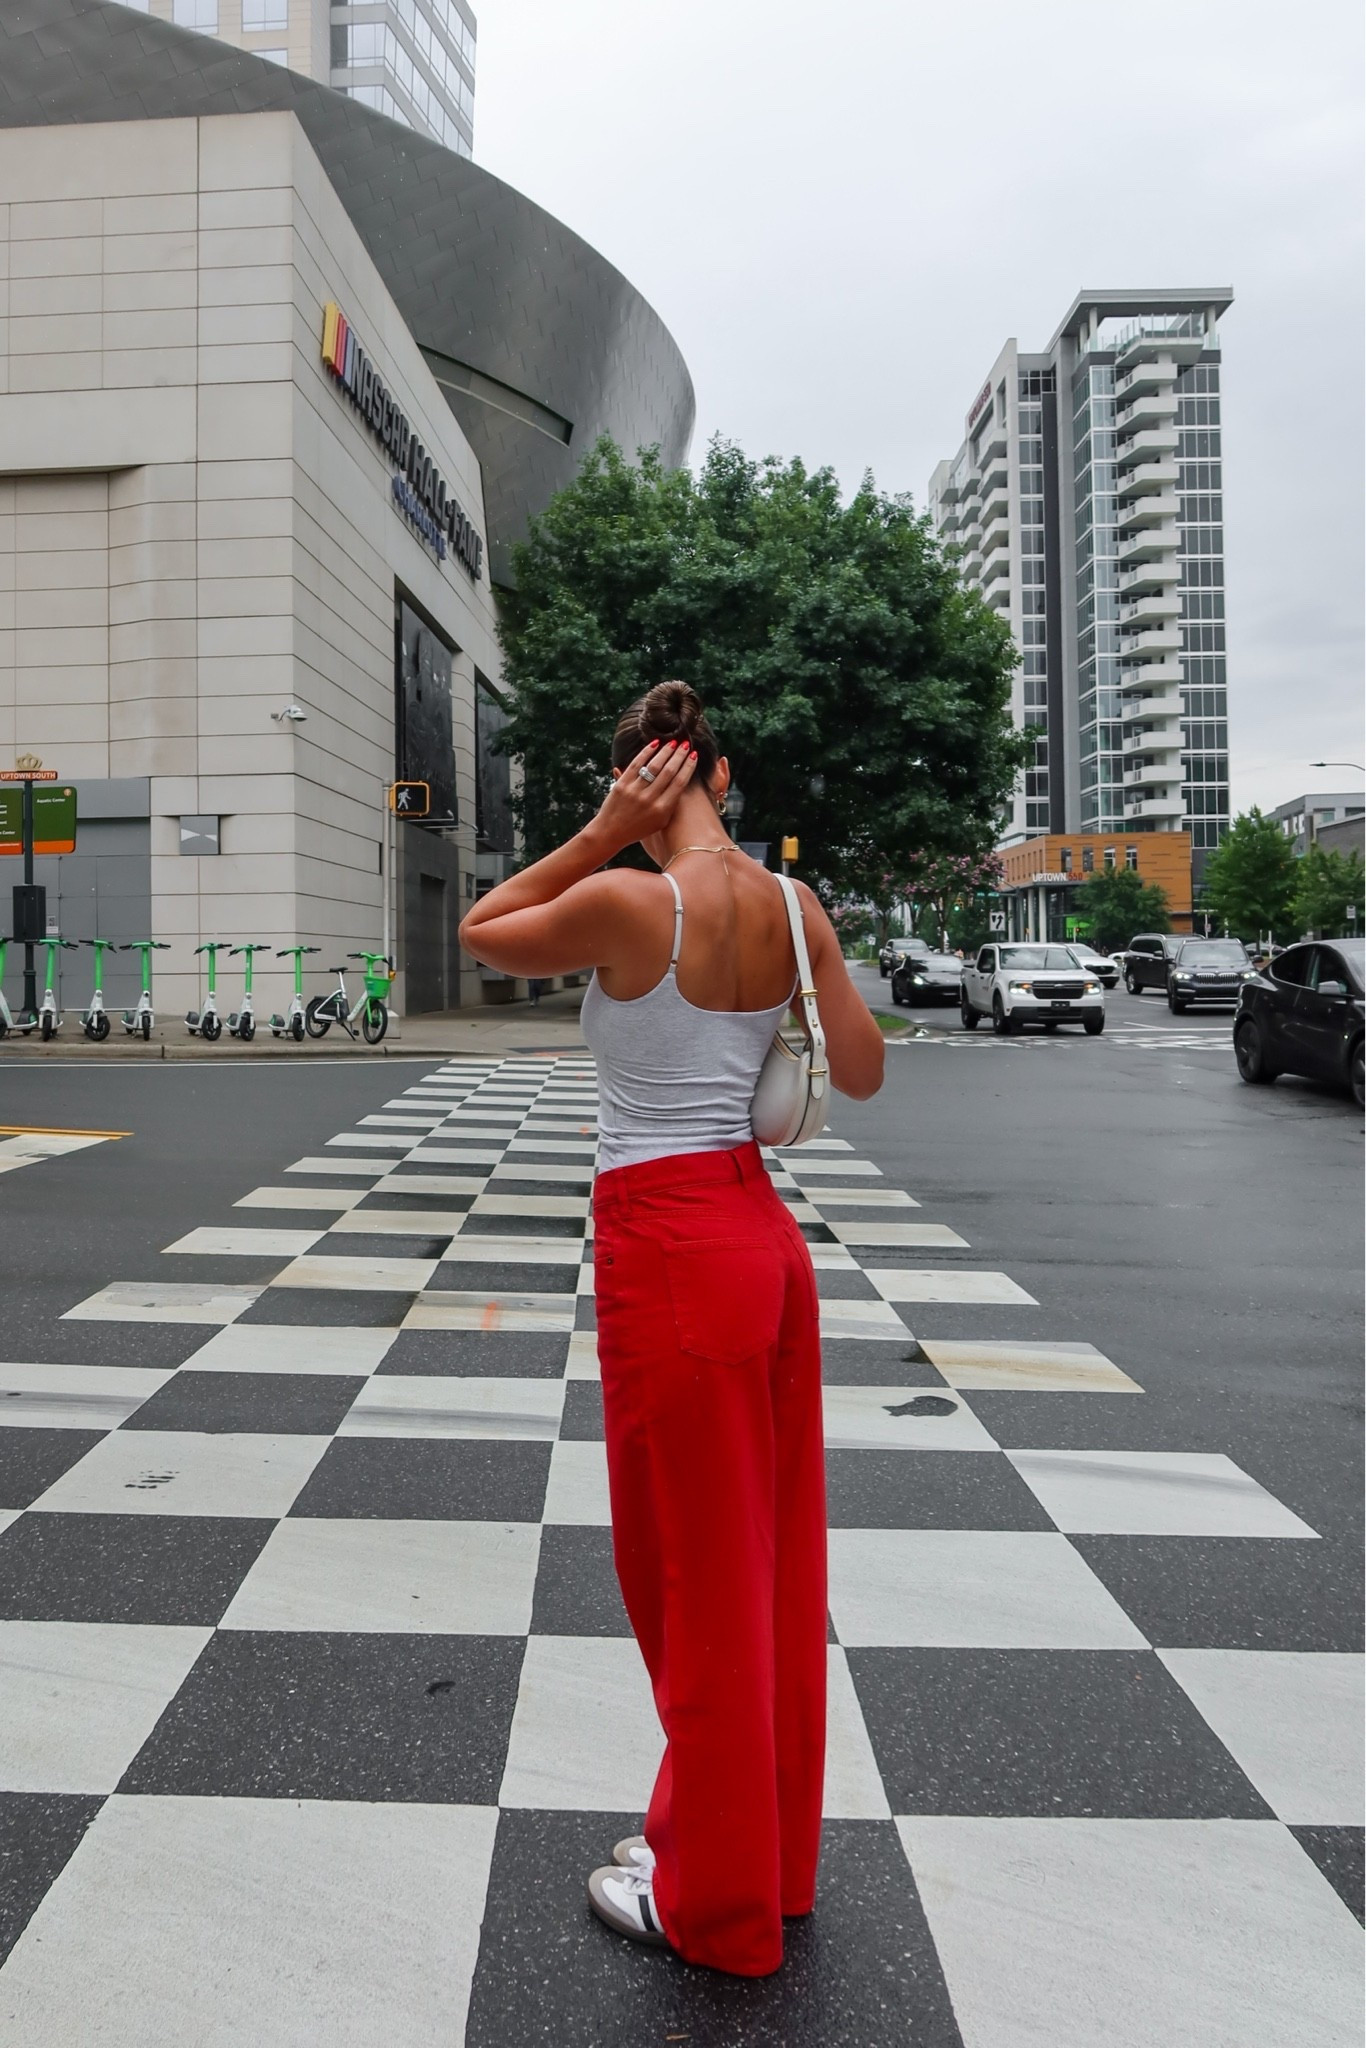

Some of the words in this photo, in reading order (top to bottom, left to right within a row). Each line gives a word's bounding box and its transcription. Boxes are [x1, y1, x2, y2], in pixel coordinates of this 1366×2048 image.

[350, 337, 410, 471] NASCAR
[407, 434, 450, 531] HALL
[449, 499, 483, 580] FAME
[0, 772, 31, 780] UPTOWN
[1032, 872, 1066, 882] UPTOWN
[1068, 872, 1083, 881] 550
